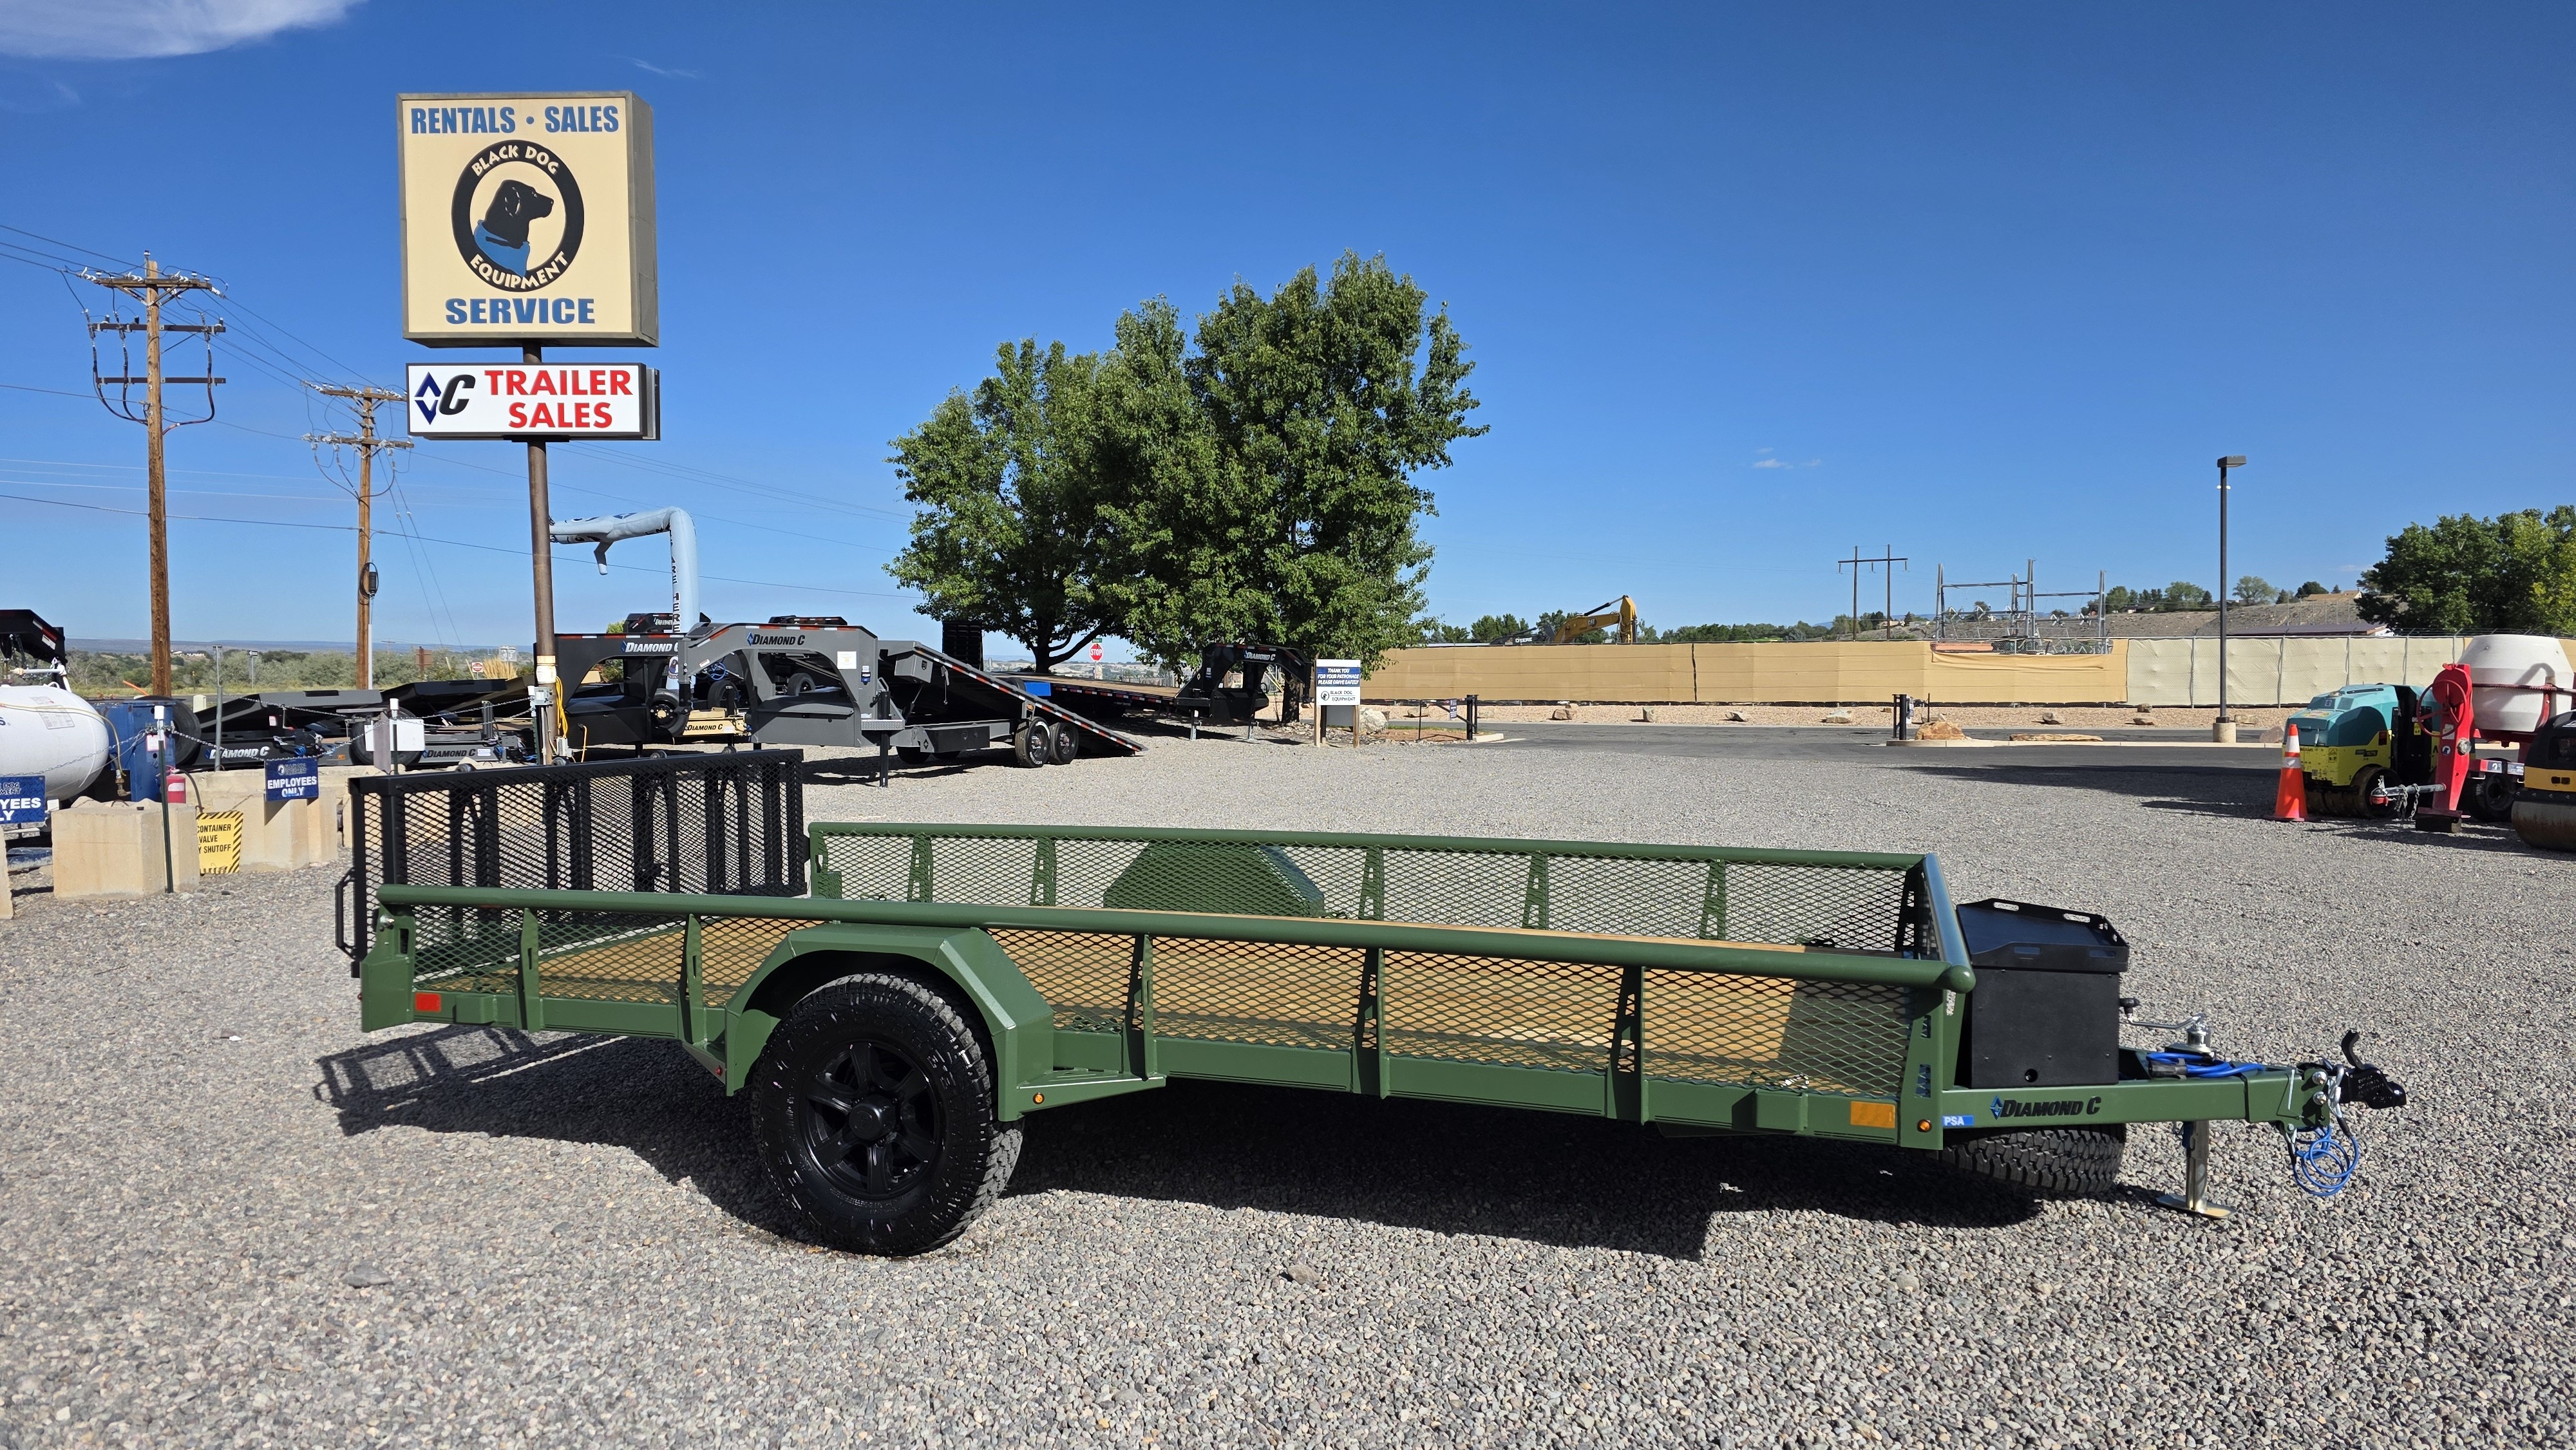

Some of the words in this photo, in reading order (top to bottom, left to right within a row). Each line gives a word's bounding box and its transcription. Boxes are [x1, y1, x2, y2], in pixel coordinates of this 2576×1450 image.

[411, 107, 516, 134] RENTALS
[545, 106, 619, 133] SALES
[471, 145, 518, 176] BLACK
[525, 146, 559, 175] DOG
[470, 250, 568, 289] EQUIPMENT
[446, 298, 595, 325] SERVICE
[484, 370, 633, 395] TRAILER
[508, 402, 612, 428] SALES
[753, 634, 796, 645] DIAMOND
[797, 634, 806, 645] C
[625, 642, 670, 652] DIAMOND
[1247, 652, 1271, 661] DIAMOND
[209, 749, 259, 759] DAMOND
[260, 746, 270, 757] C
[427, 749, 467, 758] DIAMOND
[267, 776, 317, 789] EMPLOYEES
[281, 786, 305, 798] ONLY
[199, 834, 218, 843] VALVE
[204, 843, 231, 854] SHUTOFF
[2000, 1099, 2084, 1118] DIAMOND
[2087, 1096, 2102, 1115] C
[1944, 1116, 1965, 1127] PSA
